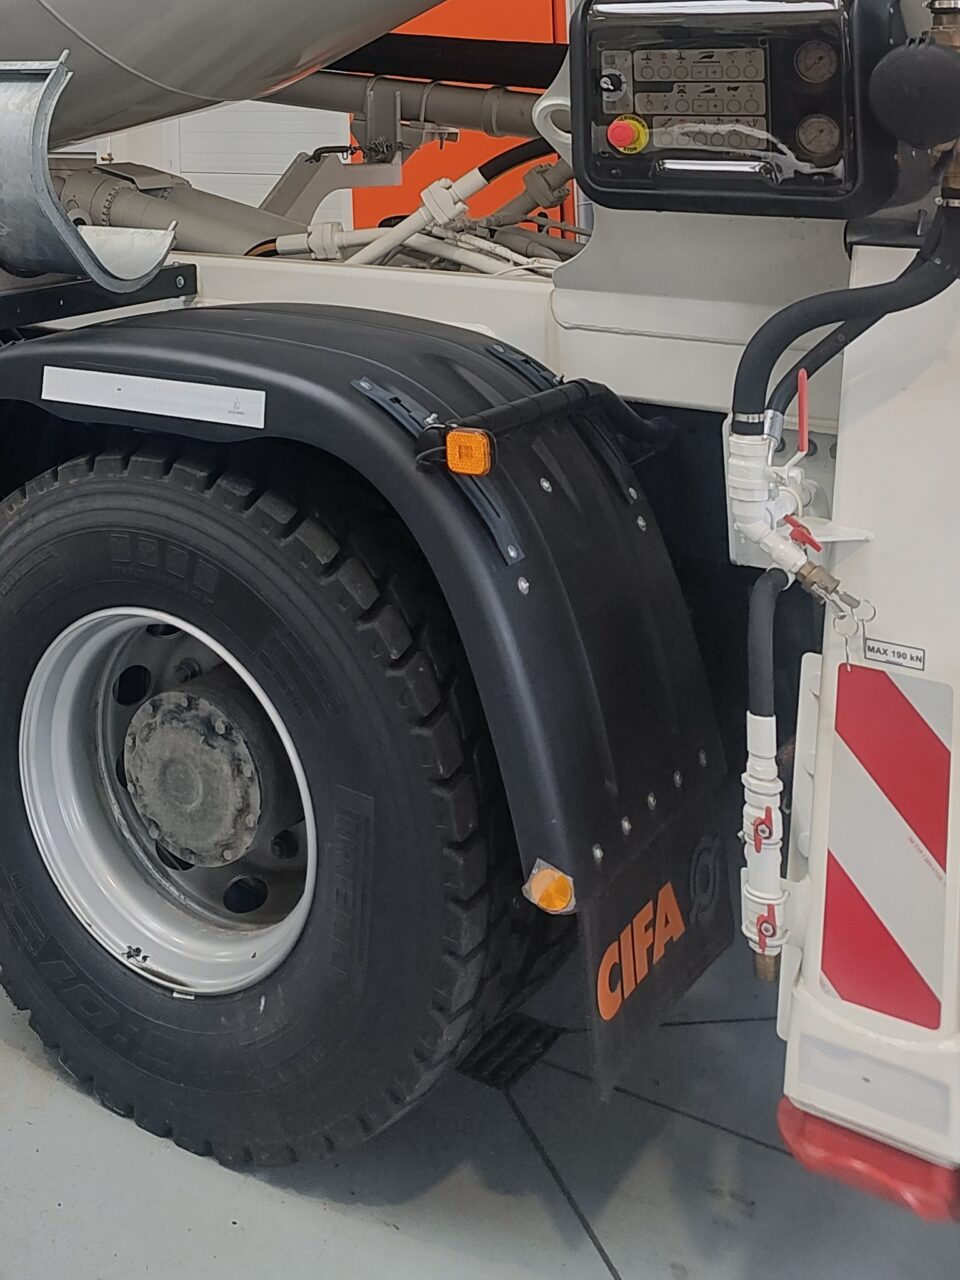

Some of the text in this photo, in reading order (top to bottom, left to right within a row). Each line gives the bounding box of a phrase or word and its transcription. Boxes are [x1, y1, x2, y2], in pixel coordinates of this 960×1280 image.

[867, 645, 889, 657] MAX
[891, 650, 908, 660] 190
[910, 653, 923, 664] kN
[596, 880, 687, 1022] CIFA
